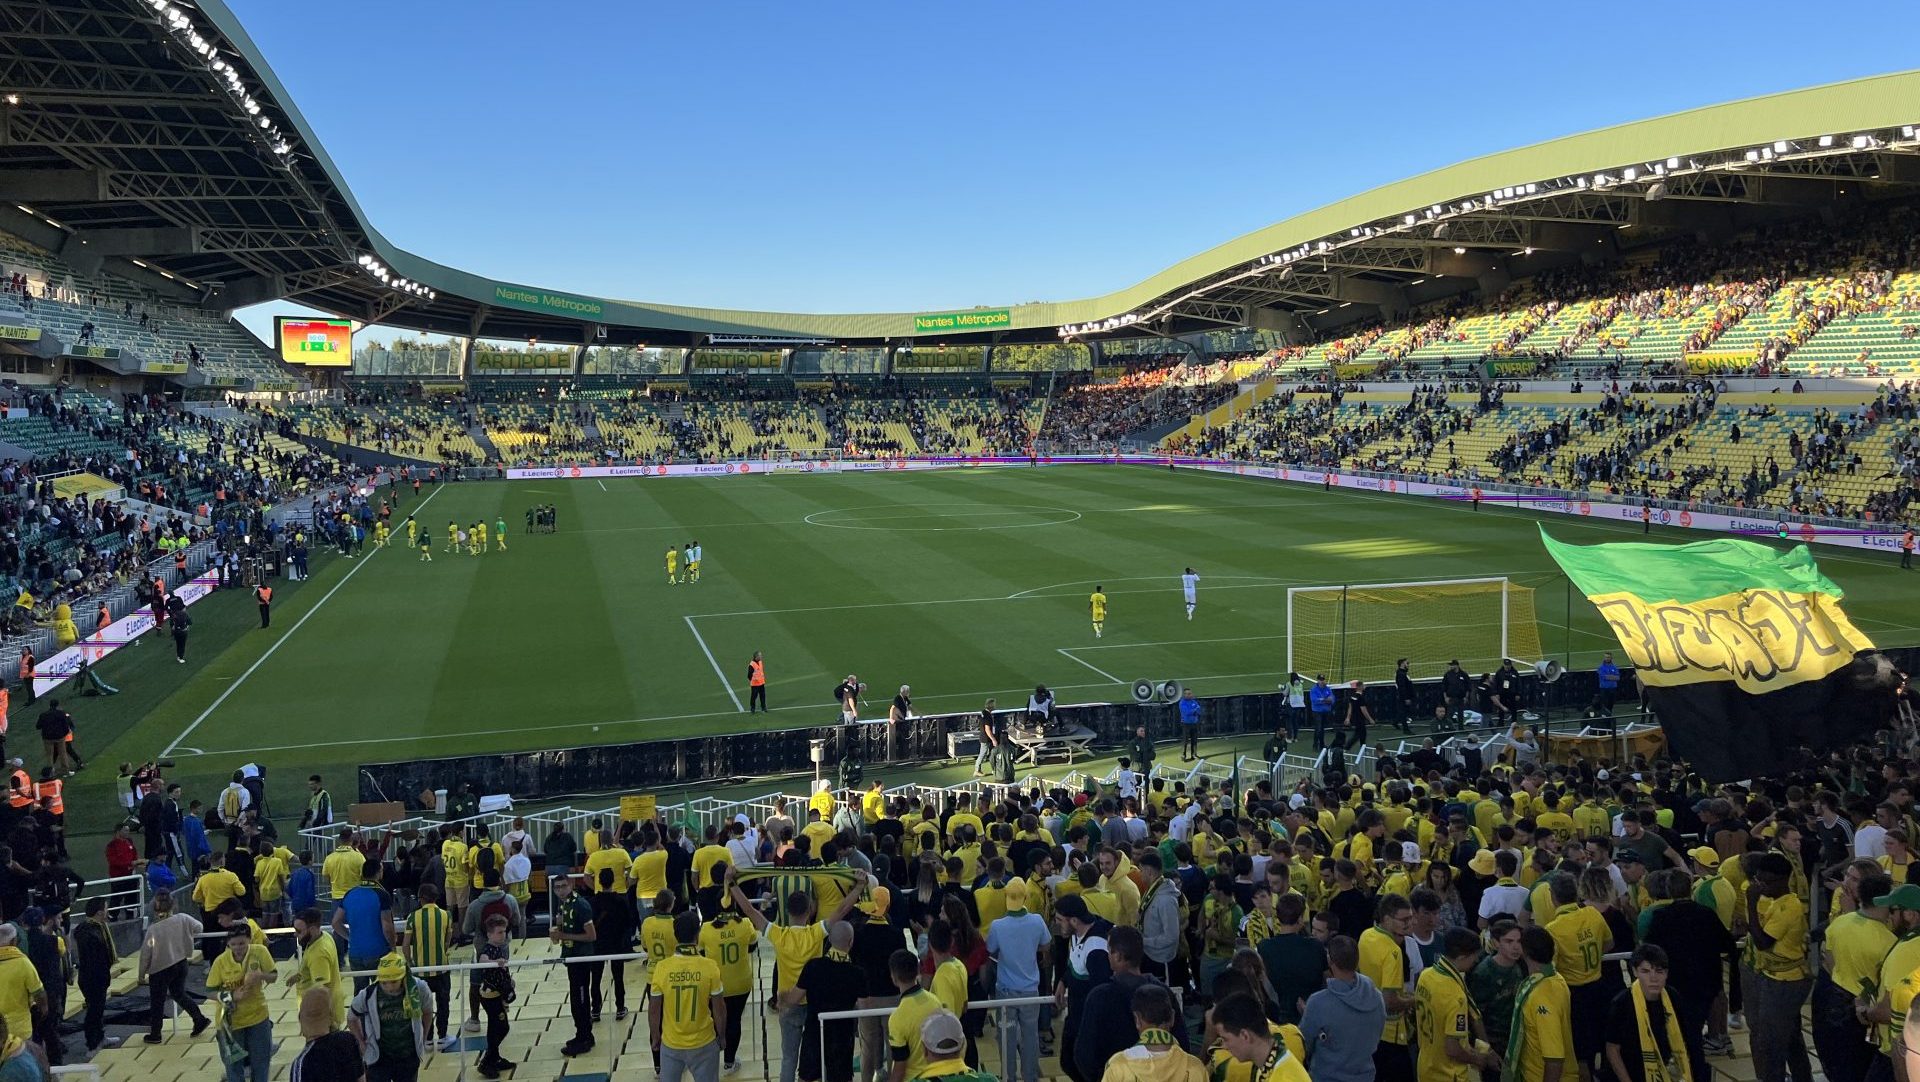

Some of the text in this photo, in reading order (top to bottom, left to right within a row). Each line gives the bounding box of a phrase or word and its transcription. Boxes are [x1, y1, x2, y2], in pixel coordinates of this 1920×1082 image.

[496, 287, 601, 313] Nantes Métropole
[916, 313, 1008, 328] Nantes Métropole
[5, 326, 28, 339] NANTES
[304, 343, 311, 351] 0
[323, 343, 330, 351] 0
[478, 353, 569, 369] ARTIPOLE
[697, 353, 779, 369] ARTIPOLE
[899, 352, 977, 368] ARTIPOLE
[1688, 358, 1705, 371] FC
[263, 382, 293, 391] FC NANTES
[1590, 825, 1602, 837] 10
[443, 854, 456, 870] 20
[720, 929, 735, 939] BLAS
[1577, 928, 1594, 942] BLAS
[653, 942, 665, 960] 9
[719, 943, 739, 965] 10
[1578, 942, 1600, 972] 10
[668, 970, 701, 982] SISSOKO
[671, 984, 698, 1022] 17
